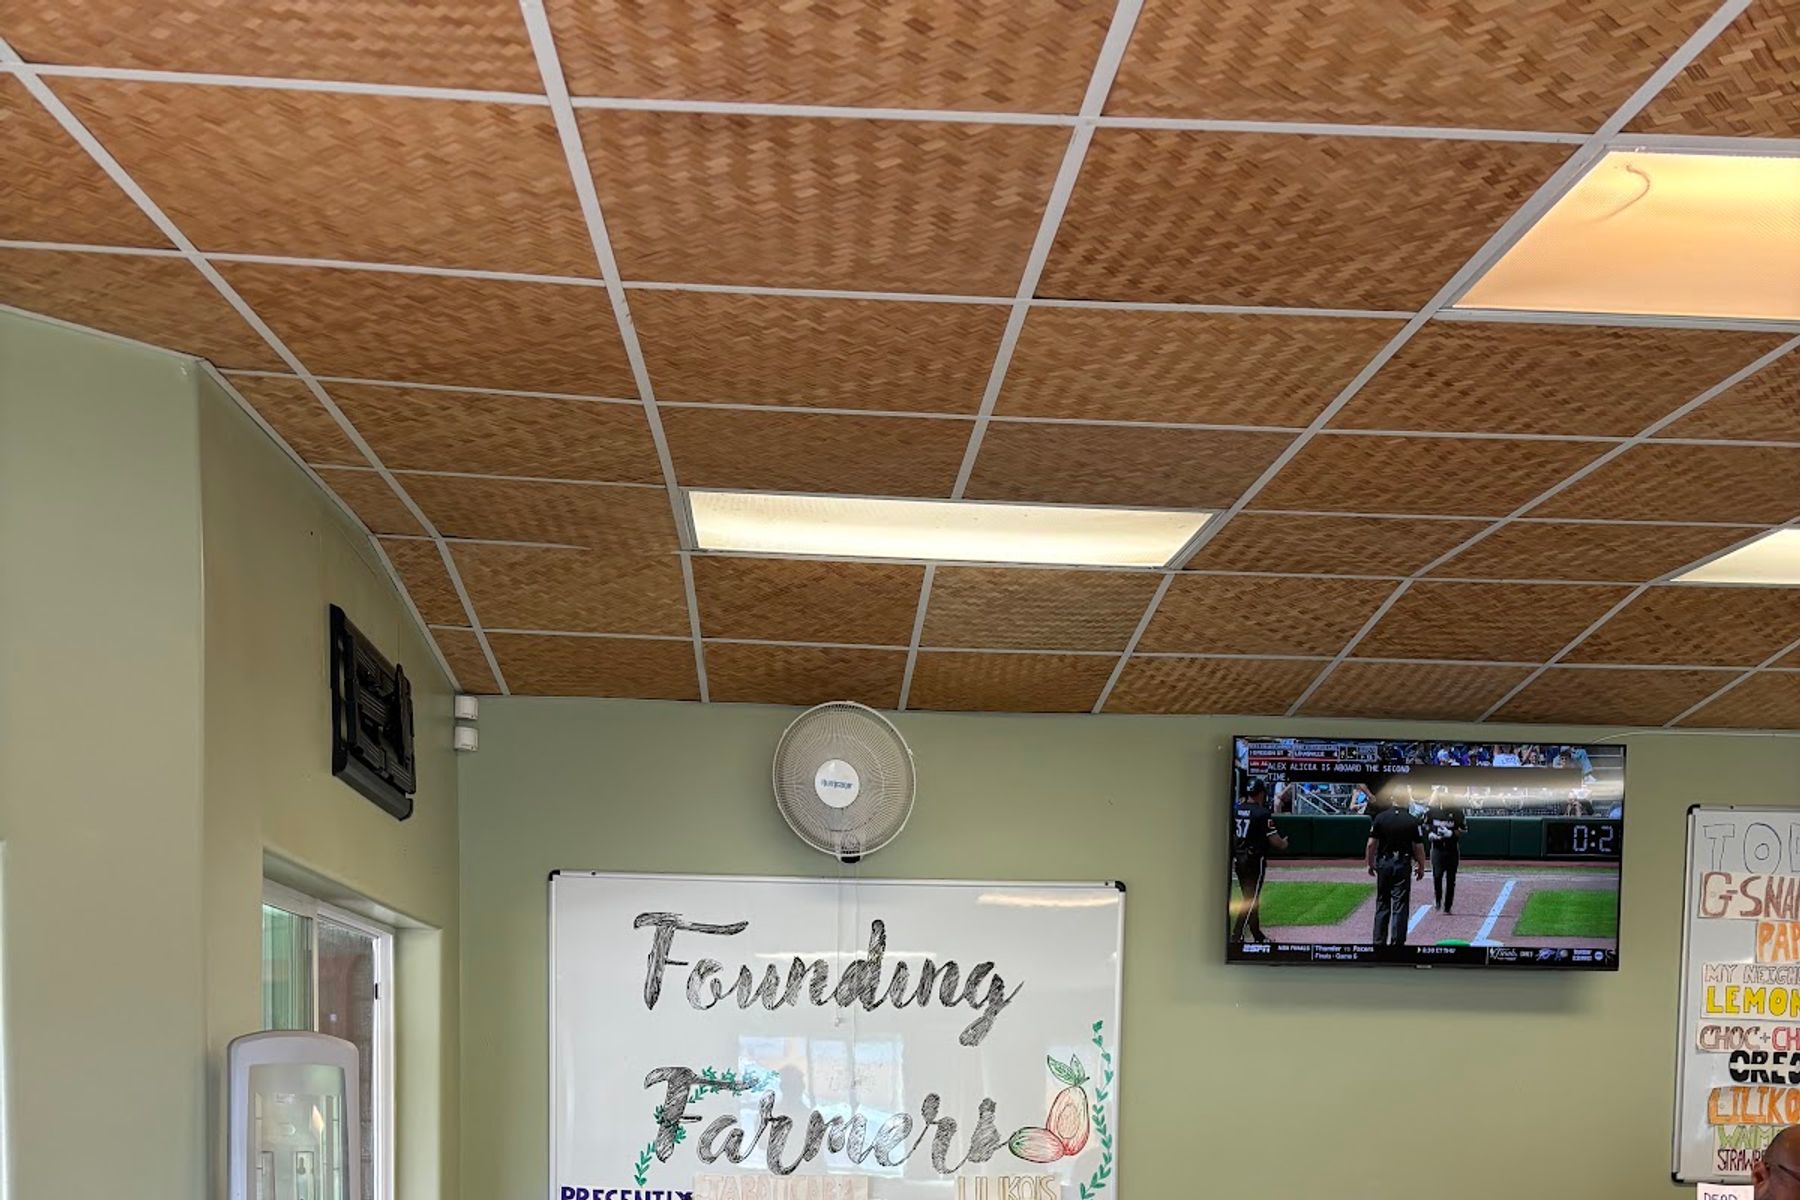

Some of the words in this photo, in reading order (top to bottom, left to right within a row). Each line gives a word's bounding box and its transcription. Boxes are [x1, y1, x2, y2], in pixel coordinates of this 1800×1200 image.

[1382, 765, 1410, 774] SECOND
[1235, 818, 1250, 838] 37
[1702, 822, 1800, 875] TO
[633, 911, 1025, 1046] Founding
[1704, 964, 1738, 983] MY
[644, 1064, 1014, 1175] Farmers
[1717, 1125, 1780, 1149] WAIM
